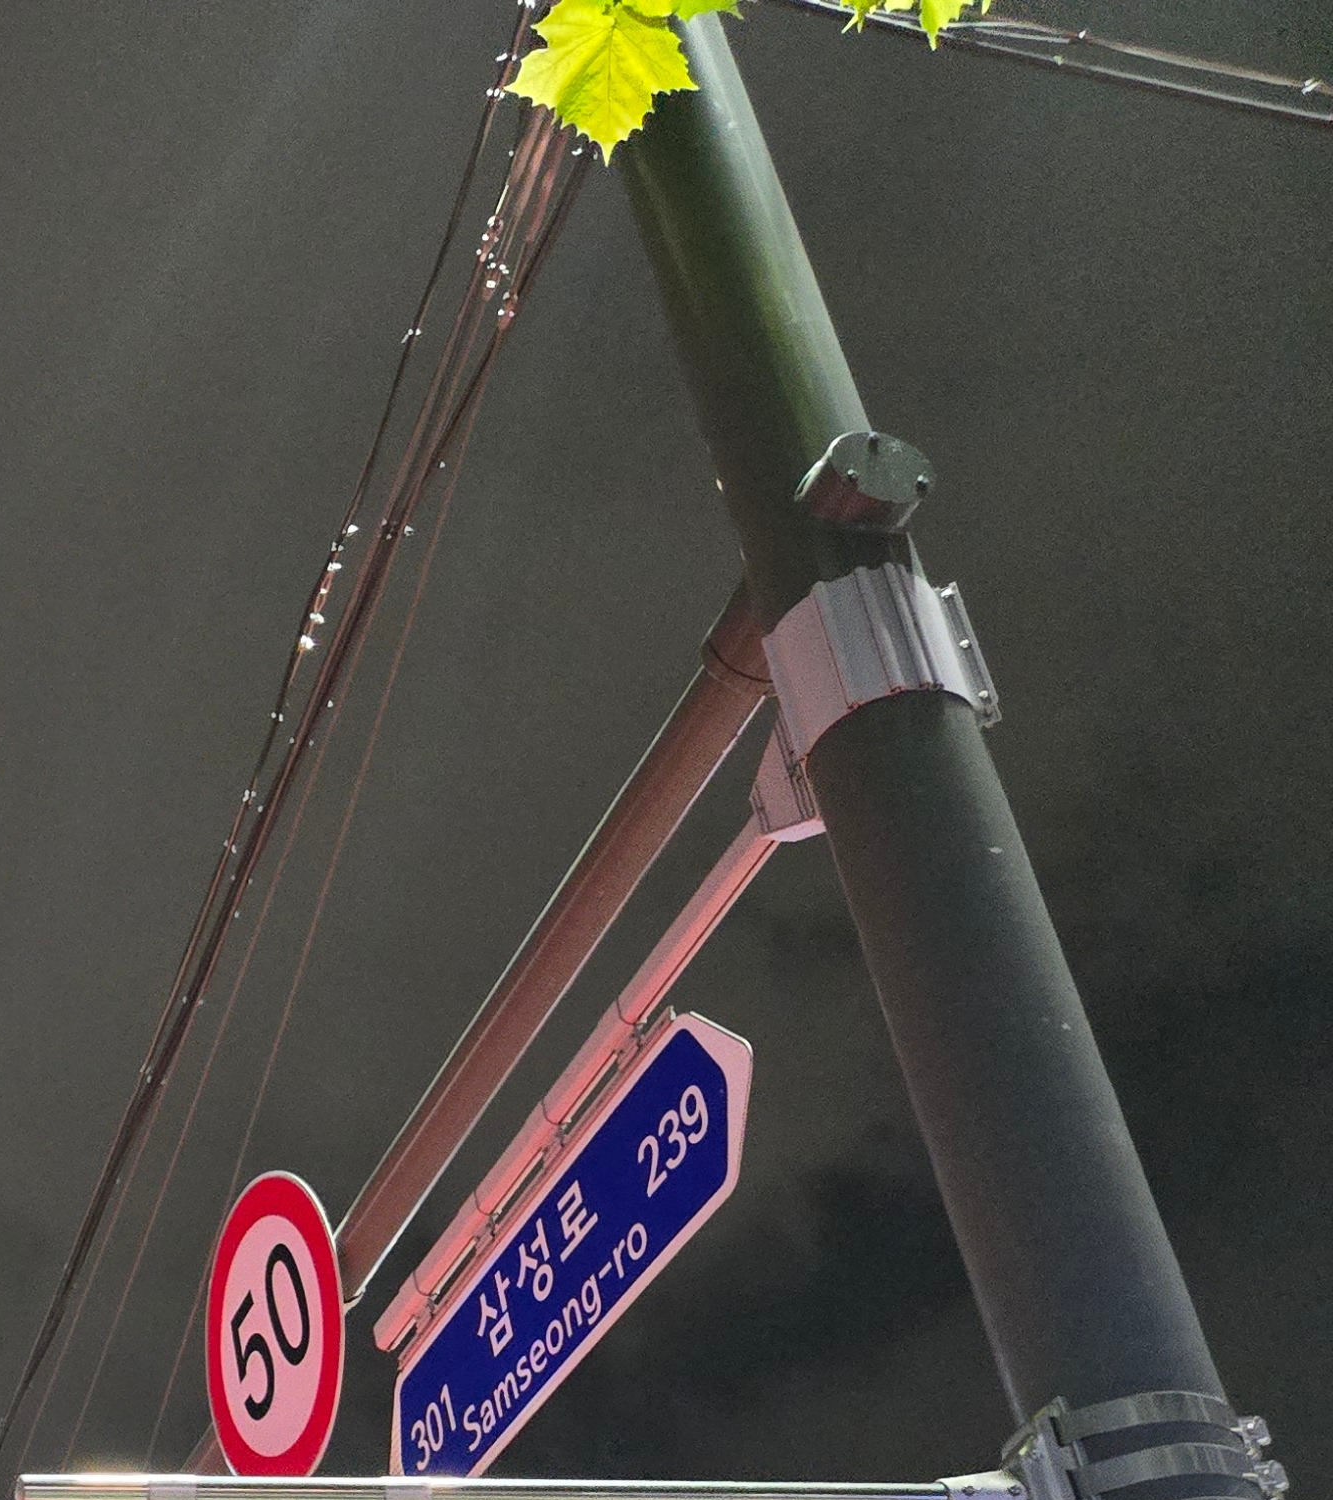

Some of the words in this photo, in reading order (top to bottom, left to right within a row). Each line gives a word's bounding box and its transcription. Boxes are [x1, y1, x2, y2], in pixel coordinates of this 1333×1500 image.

[637, 1083, 710, 1198] 239
[230, 1243, 309, 1422] 50
[461, 1221, 649, 1453] Samseong-ro
[476, 1180, 599, 1357] 삼성로
[411, 1384, 457, 1472] 301
